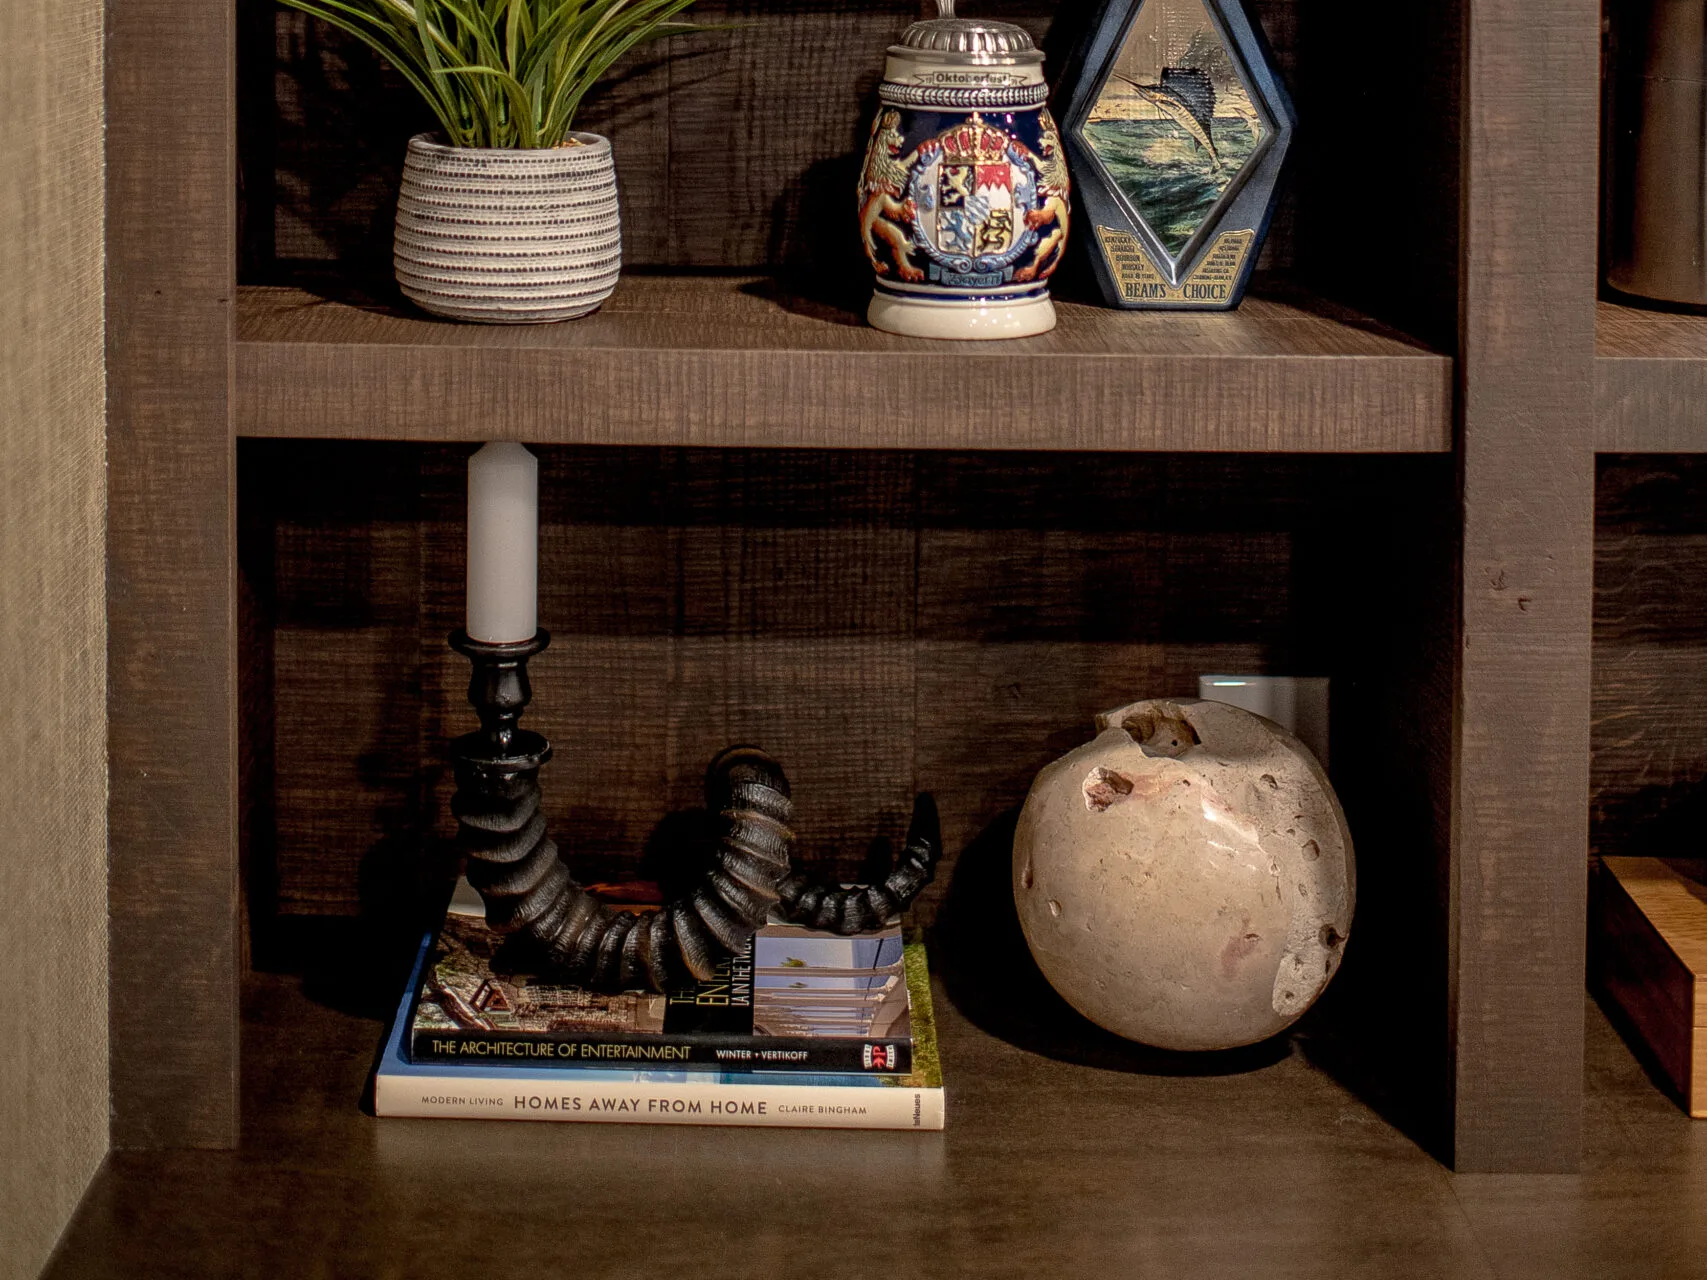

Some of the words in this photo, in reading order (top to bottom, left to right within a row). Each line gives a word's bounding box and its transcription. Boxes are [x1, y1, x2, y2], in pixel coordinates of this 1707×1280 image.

[936, 72, 1007, 84] Oktoberfest
[1183, 283, 1227, 299] CHOICE
[732, 965, 752, 982] THE
[432, 1039, 456, 1056] THE
[459, 1040, 555, 1059] ARCHITECTURE
[557, 1043, 578, 1058] OF
[581, 1043, 692, 1061] ENTERTAINMENT
[715, 1048, 752, 1061] WINTER
[760, 1050, 809, 1062] VERTIKOFF
[421, 1096, 466, 1106] MODERN
[469, 1098, 504, 1107] LIVING
[514, 1095, 581, 1112] HOMES
[588, 1098, 641, 1112] AWAY
[647, 1099, 702, 1115] FROM
[709, 1101, 767, 1116] HOME
[777, 1104, 814, 1115] CLAIRE
[817, 1105, 867, 1116] BINGHAM
[912, 1092, 921, 1128] teNeues
